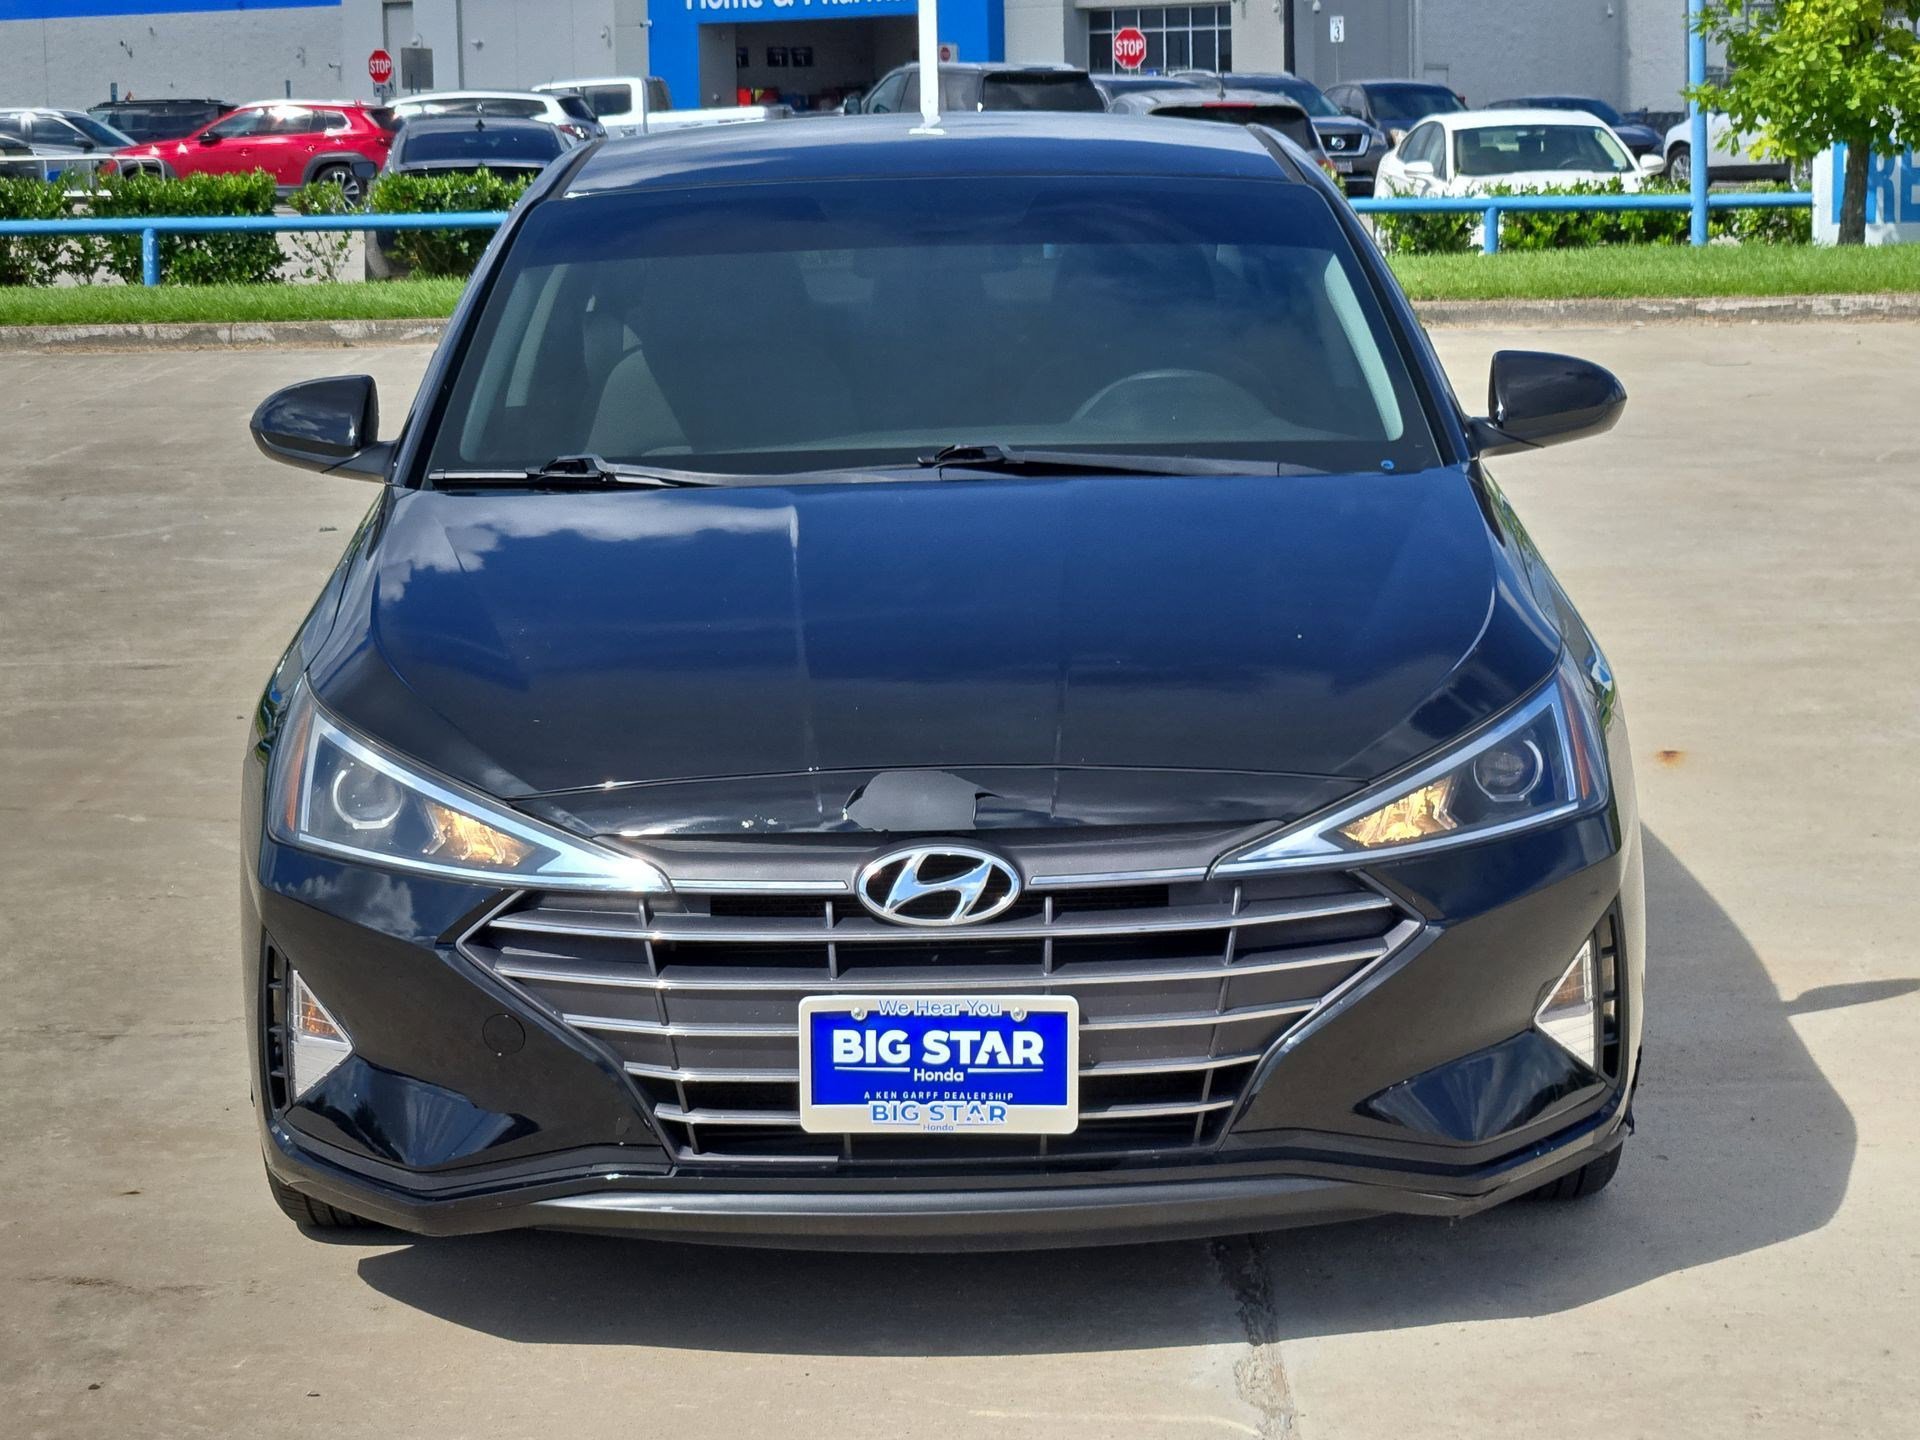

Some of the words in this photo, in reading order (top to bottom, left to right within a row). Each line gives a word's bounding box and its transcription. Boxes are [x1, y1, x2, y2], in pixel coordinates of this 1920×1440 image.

[1115, 39, 1144, 57] STOP
[370, 59, 391, 74] STOP
[879, 1000, 909, 1014] We
[916, 1000, 960, 1014] Hear
[967, 1000, 1000, 1014] You
[832, 1029, 911, 1064] BIG
[922, 1030, 1044, 1066] STAR
[913, 1068, 965, 1082] Honda
[864, 1091, 870, 1099] A
[876, 1091, 897, 1099] KEN
[903, 1091, 938, 1099] GARFF
[944, 1091, 1014, 1100] DEALERSHIP
[872, 1104, 919, 1121] BIG
[929, 1104, 1007, 1121] STAR
[923, 1123, 954, 1132] Honda
